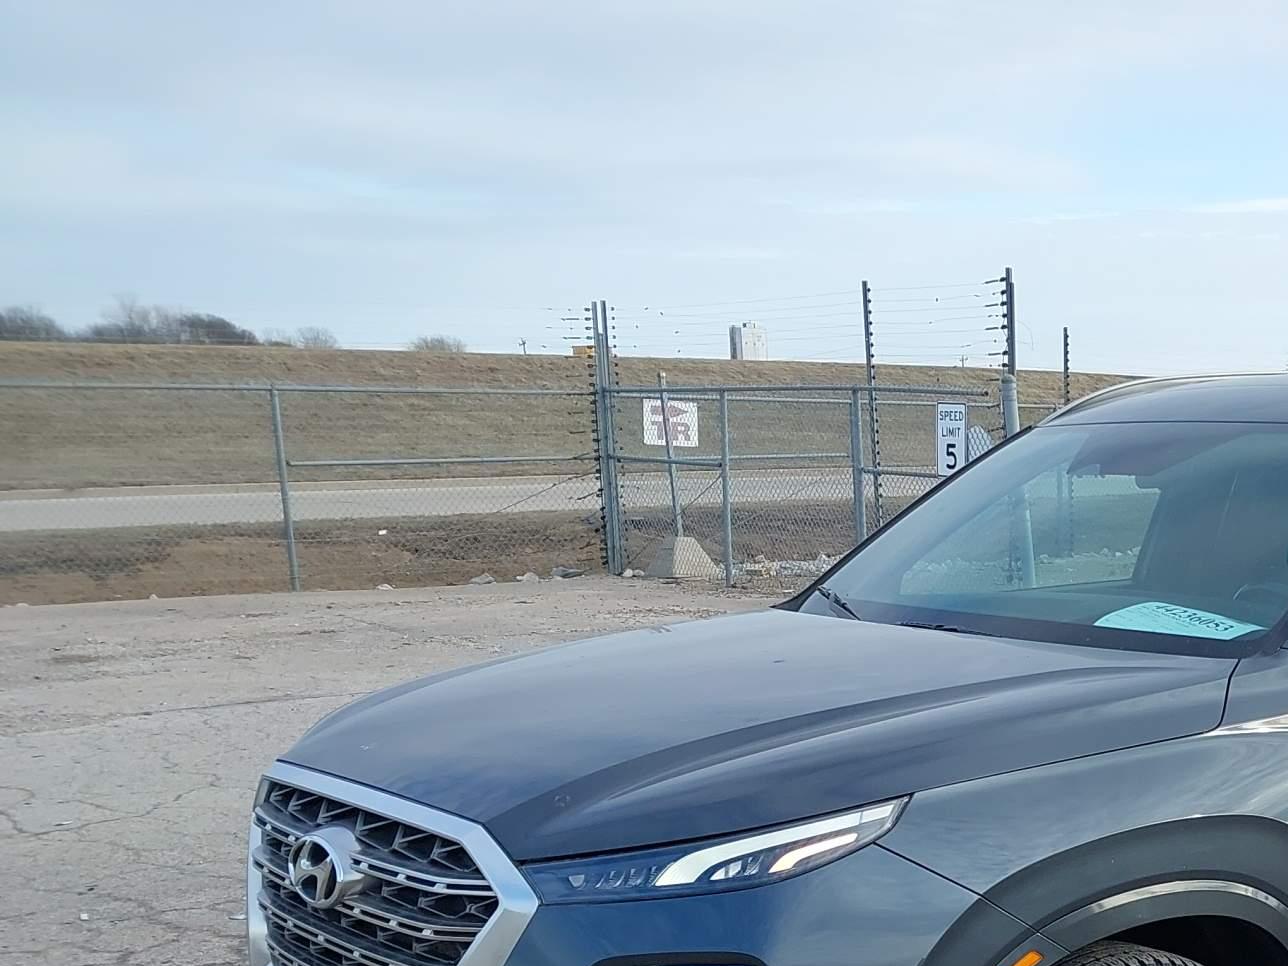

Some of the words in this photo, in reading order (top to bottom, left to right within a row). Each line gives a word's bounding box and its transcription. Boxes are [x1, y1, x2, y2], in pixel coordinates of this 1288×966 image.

[939, 410, 964, 422] SPEED
[941, 426, 961, 438] LIMIT
[946, 443, 957, 470] 5
[1154, 604, 1235, 632] 44236053
